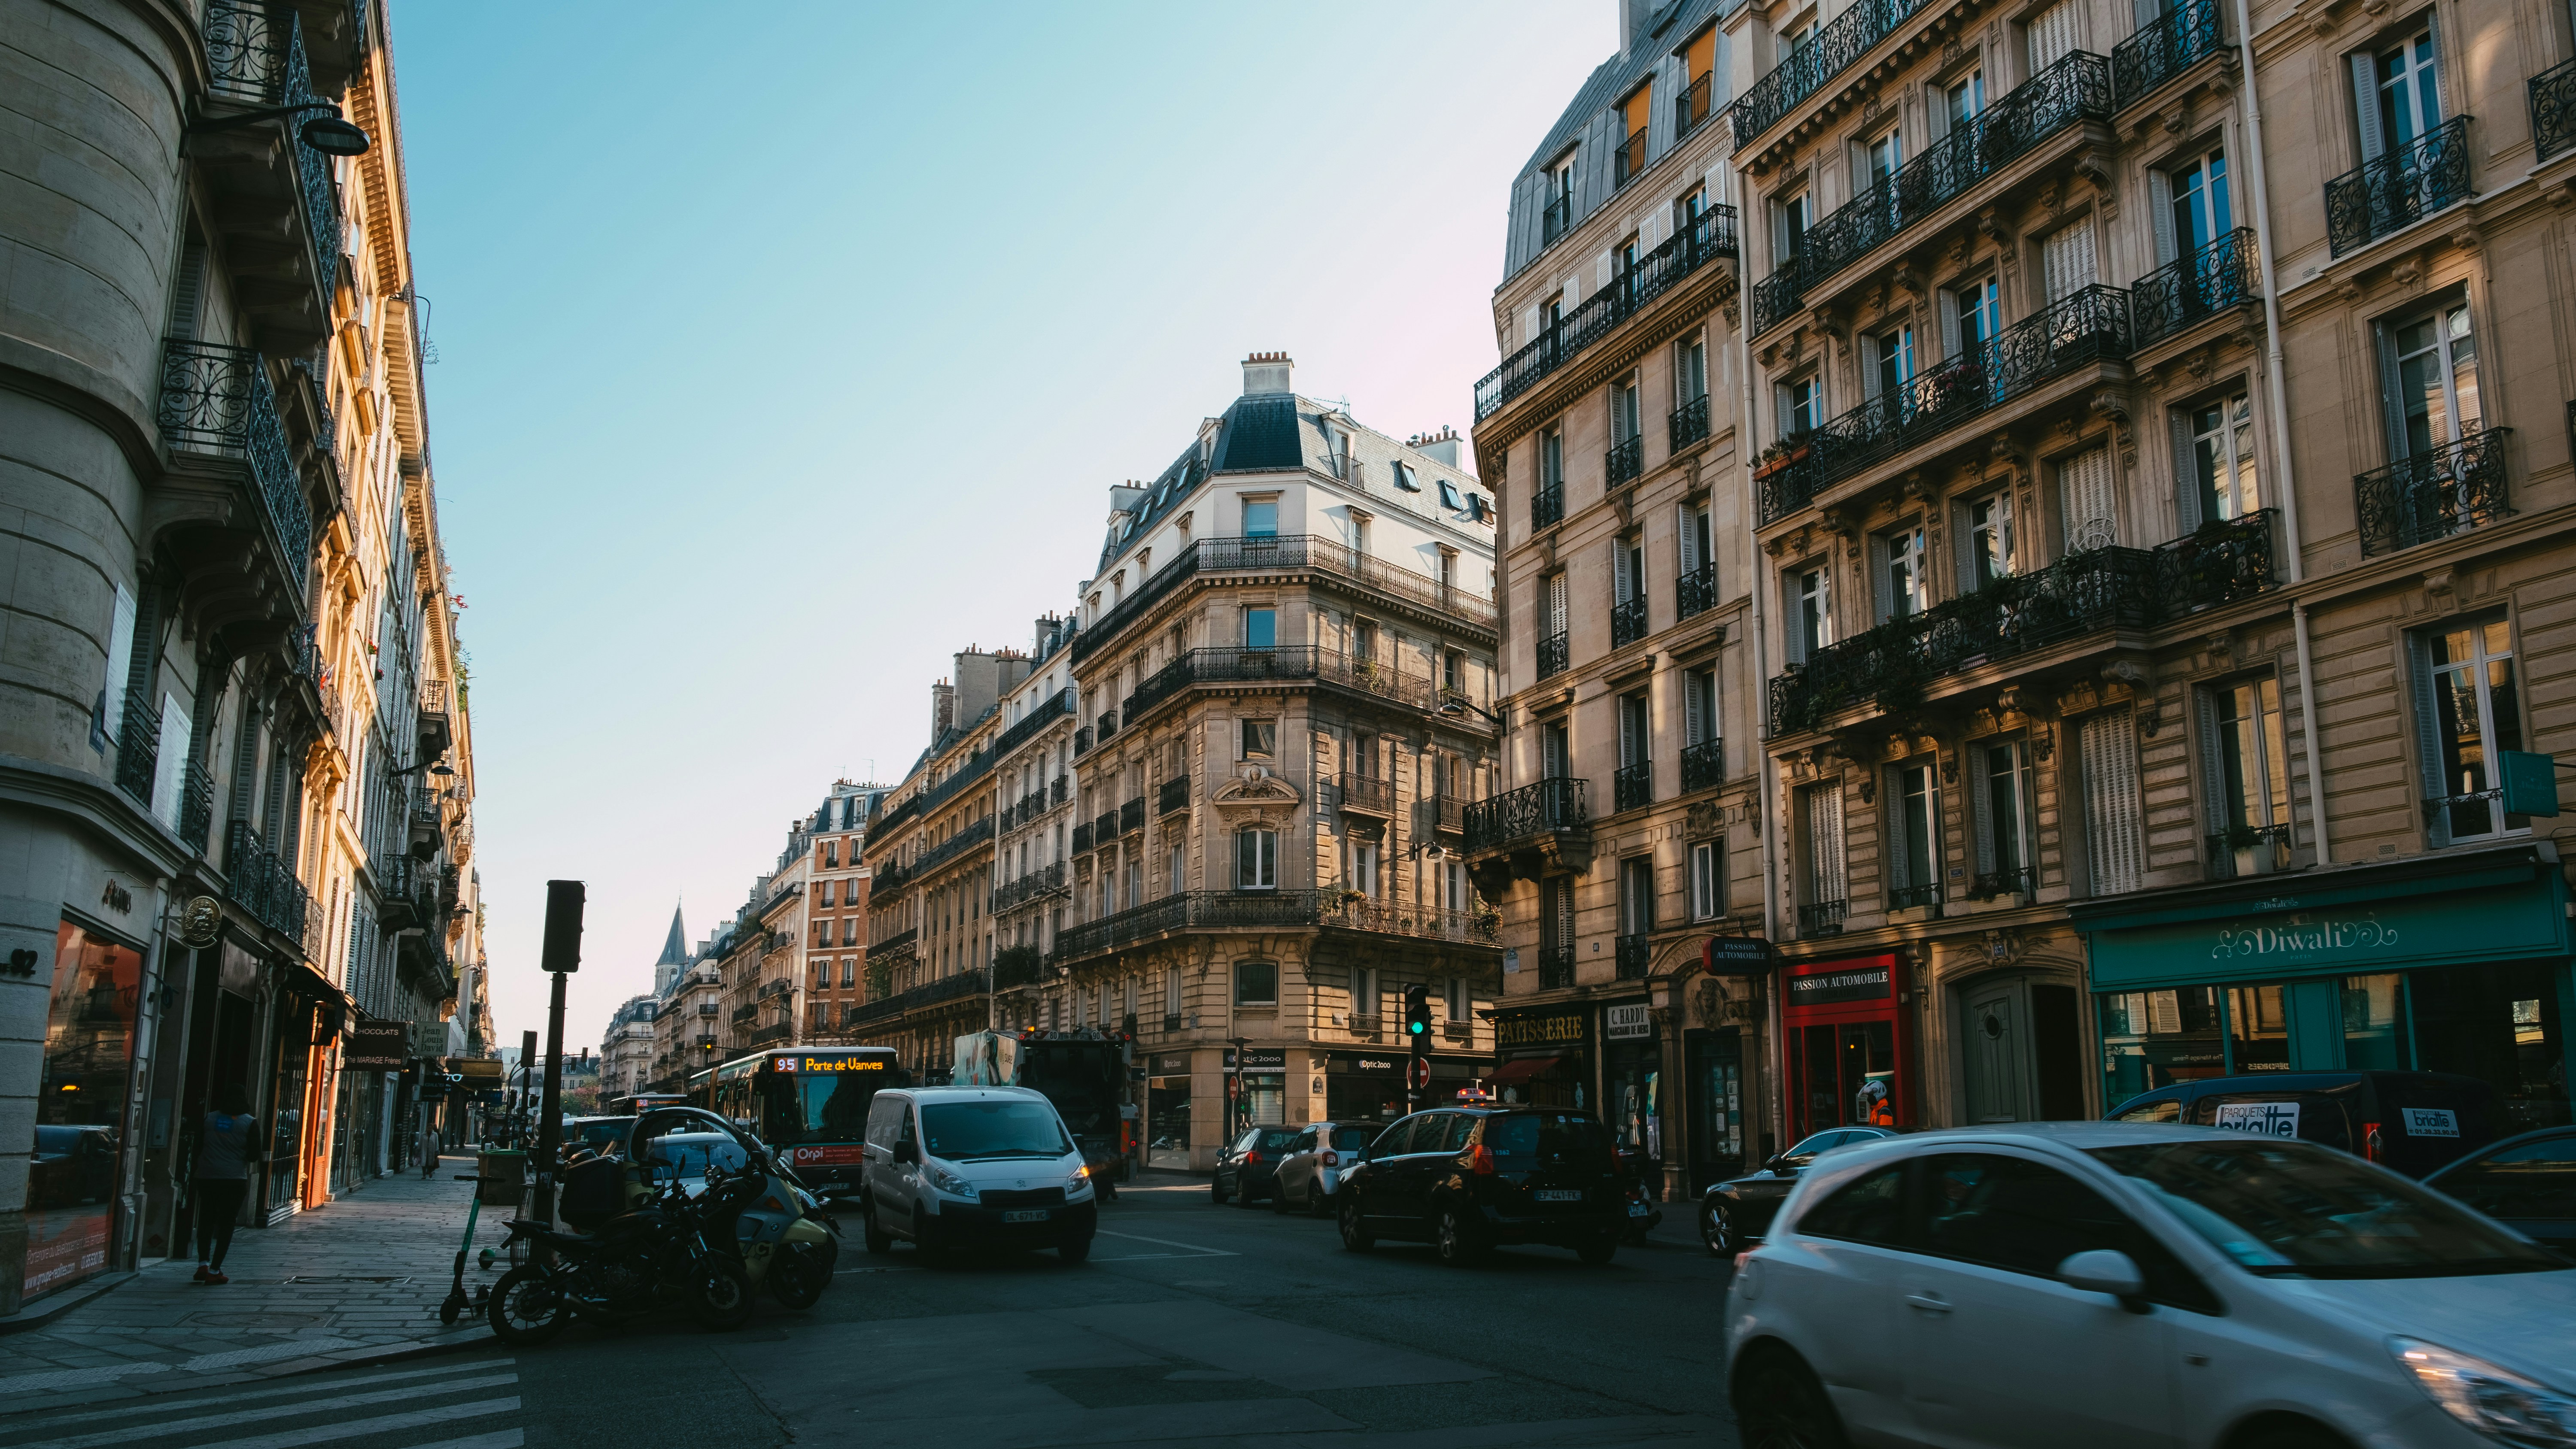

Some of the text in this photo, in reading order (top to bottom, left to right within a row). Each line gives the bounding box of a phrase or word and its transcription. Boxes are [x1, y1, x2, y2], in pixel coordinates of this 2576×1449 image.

[2254, 922, 2341, 954] Diwali
[1716, 951, 1766, 959] AUTOMOBILE
[1793, 972, 1888, 991] PASSION AUTOMOBILE
[1821, 988, 1859, 1000] LIBRAIRIE
[1612, 1007, 1645, 1025] C. HARDY
[422, 1026, 440, 1035] Jean
[1498, 1016, 1583, 1044] PATISSERIE
[1609, 1025, 1649, 1036] MARCHAND DE BIENS
[421, 1035, 443, 1043] Louis
[421, 1043, 443, 1052] David
[778, 1057, 883, 1071] 95 Porte de Vanves
[1165, 1060, 1174, 1069] Optic
[1362, 1061, 1377, 1070] Optic
[2224, 1107, 2266, 1118] PARQUETS
[797, 1147, 823, 1161] Orpi
[1007, 1211, 1045, 1221] DL-671-VC
[755, 1241, 774, 1256] C1
